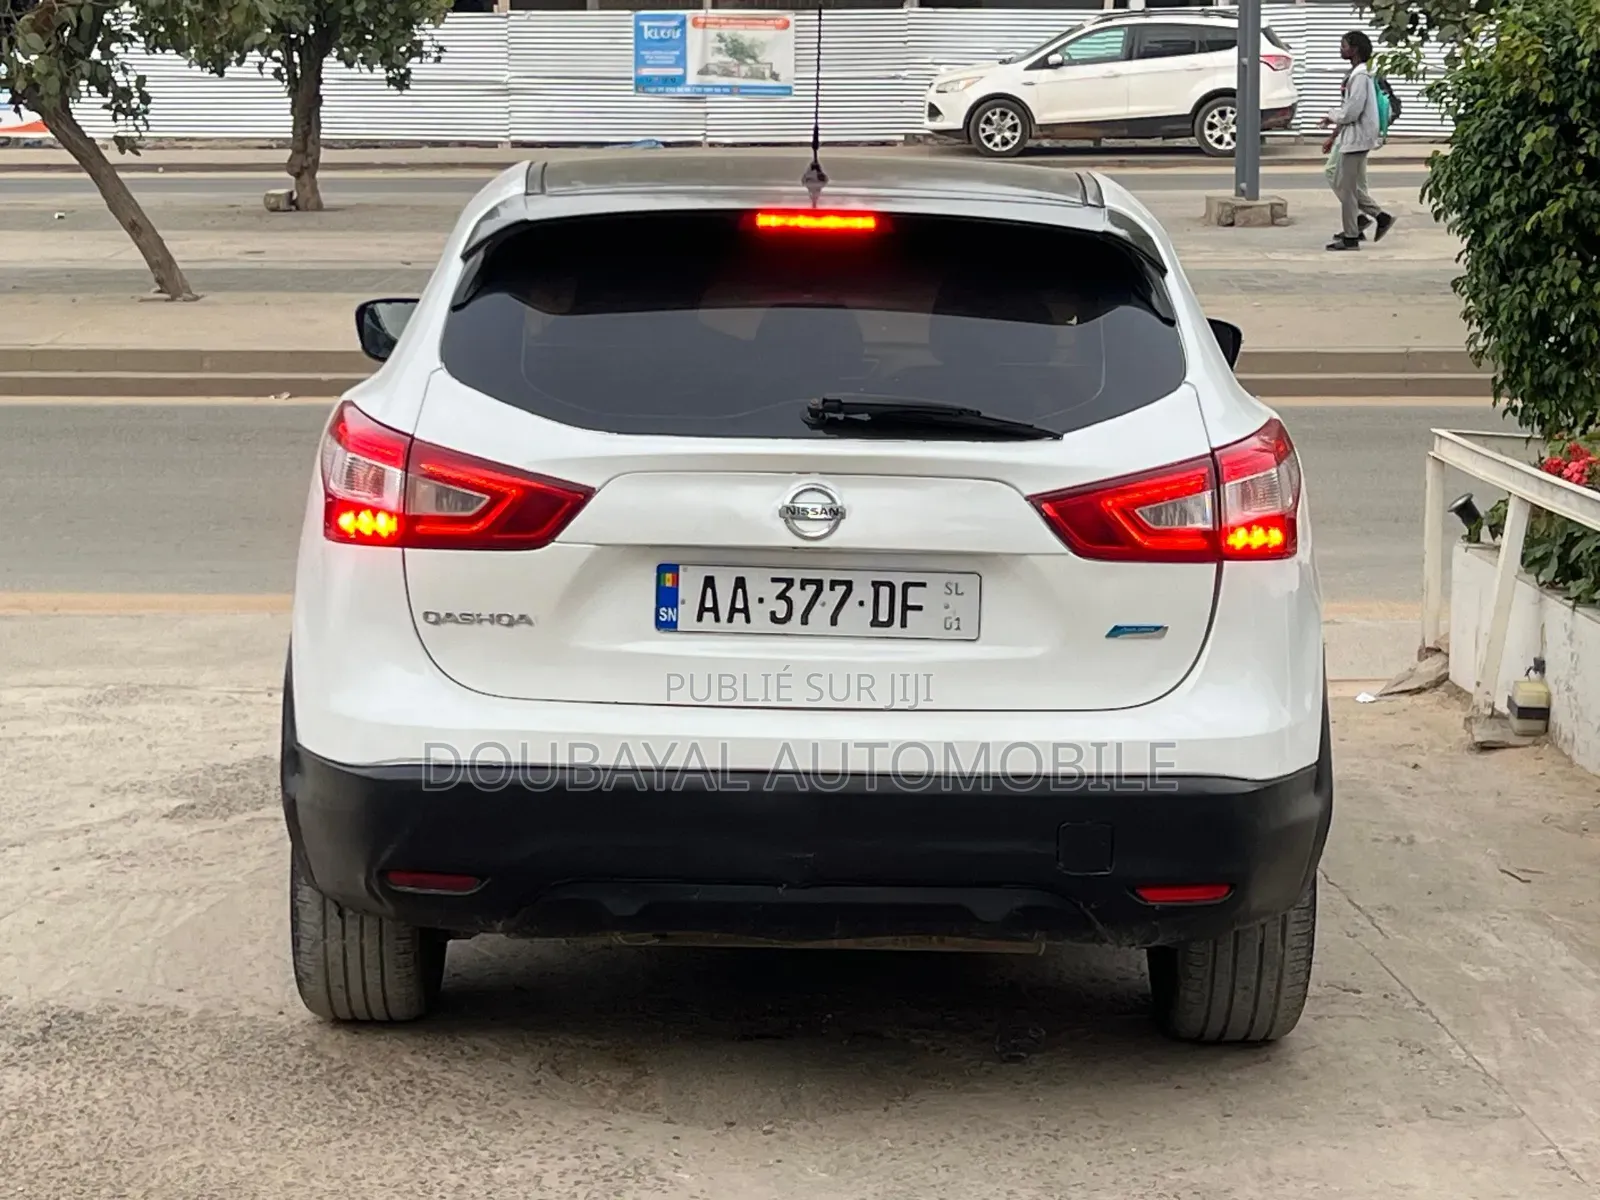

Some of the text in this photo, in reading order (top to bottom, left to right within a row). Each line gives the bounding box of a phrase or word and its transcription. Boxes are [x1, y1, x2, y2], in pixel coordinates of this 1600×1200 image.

[786, 506, 839, 516] NISSAN
[944, 582, 965, 596] SL
[659, 607, 678, 621] SN
